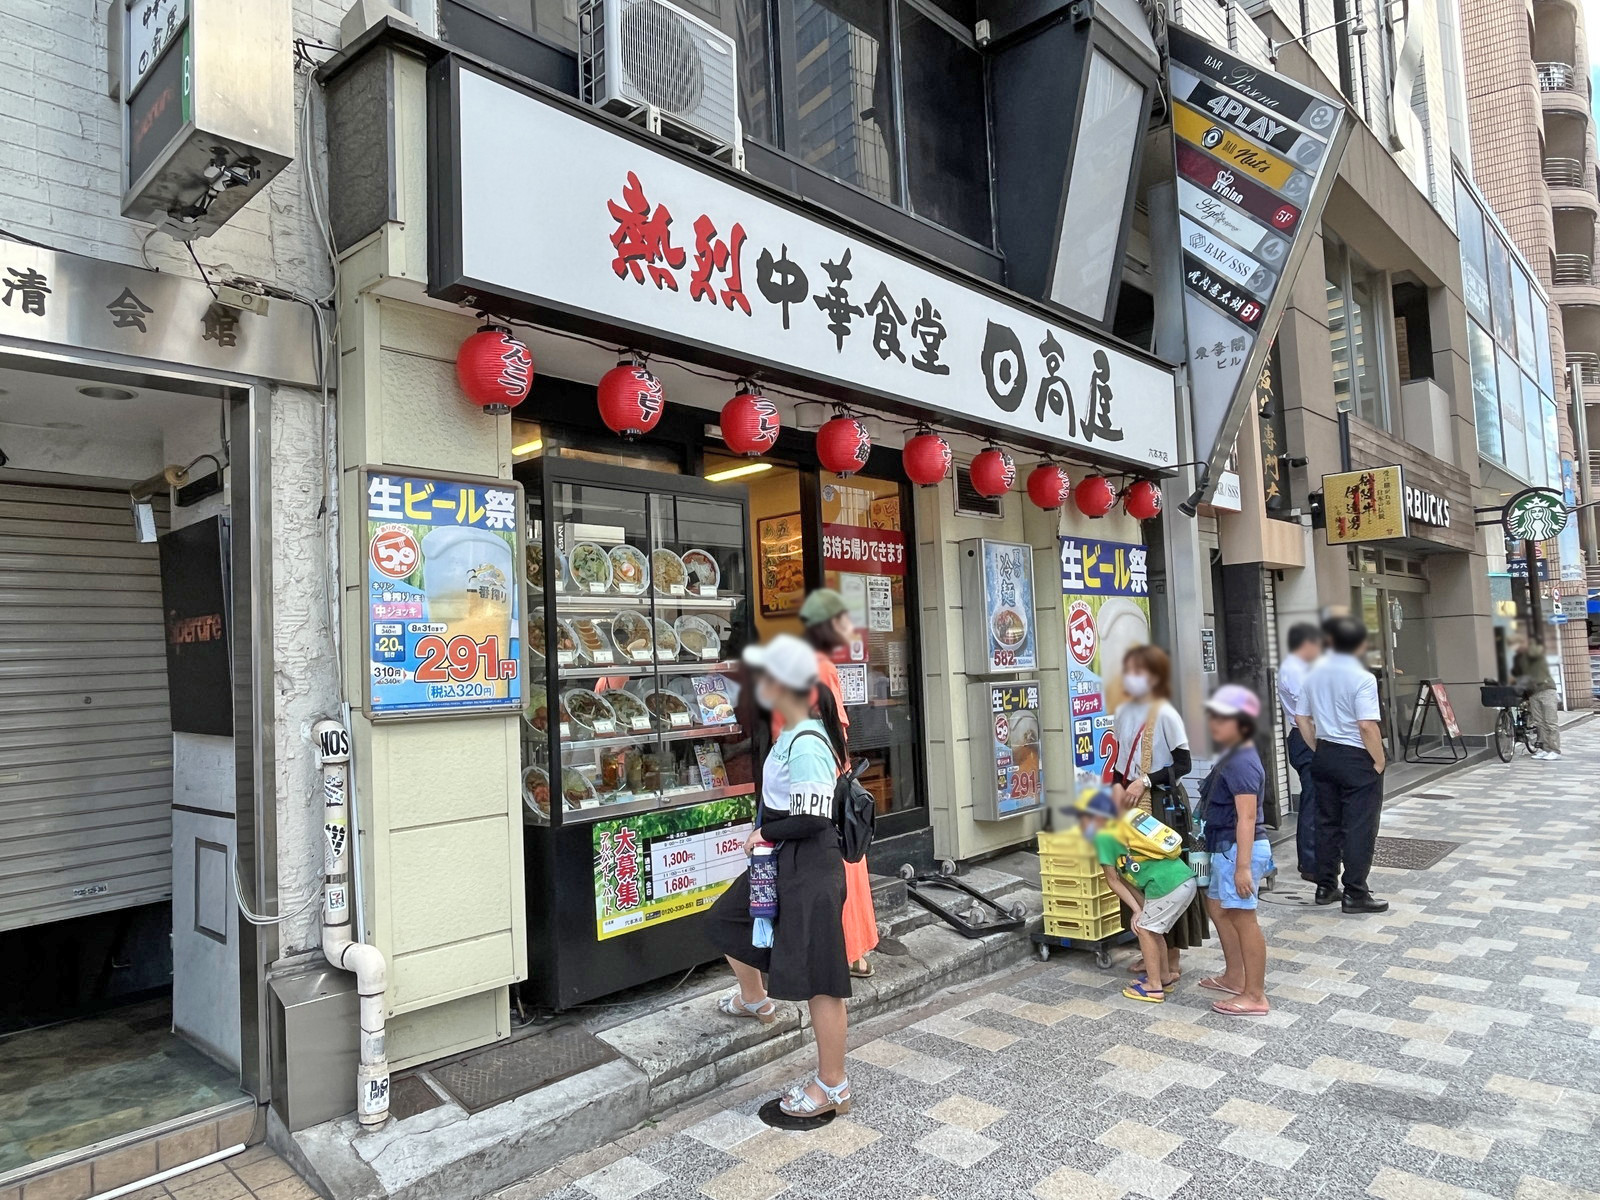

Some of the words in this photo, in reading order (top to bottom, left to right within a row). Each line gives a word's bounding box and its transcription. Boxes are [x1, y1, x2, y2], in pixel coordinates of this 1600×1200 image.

[1203, 55, 1223, 71] BAR
[1222, 65, 1280, 108] Persona
[1207, 95, 1287, 142] 4PLAY
[1275, 210, 1294, 223] 5F
[607, 170, 950, 376] 熱烈中華食堂
[1241, 303, 1260, 321] B1
[367, 476, 516, 529] 生ビール祭
[1406, 486, 1450, 528] RBUCKS
[822, 535, 904, 564] お持ち帰りできます
[1061, 540, 1149, 593] 生ビール祭
[372, 581, 395, 591] キリン
[373, 667, 401, 678] 310円
[415, 635, 518, 683] 291円
[992, 686, 1038, 713] 生ビール祭
[614, 826, 640, 910] 大募集
